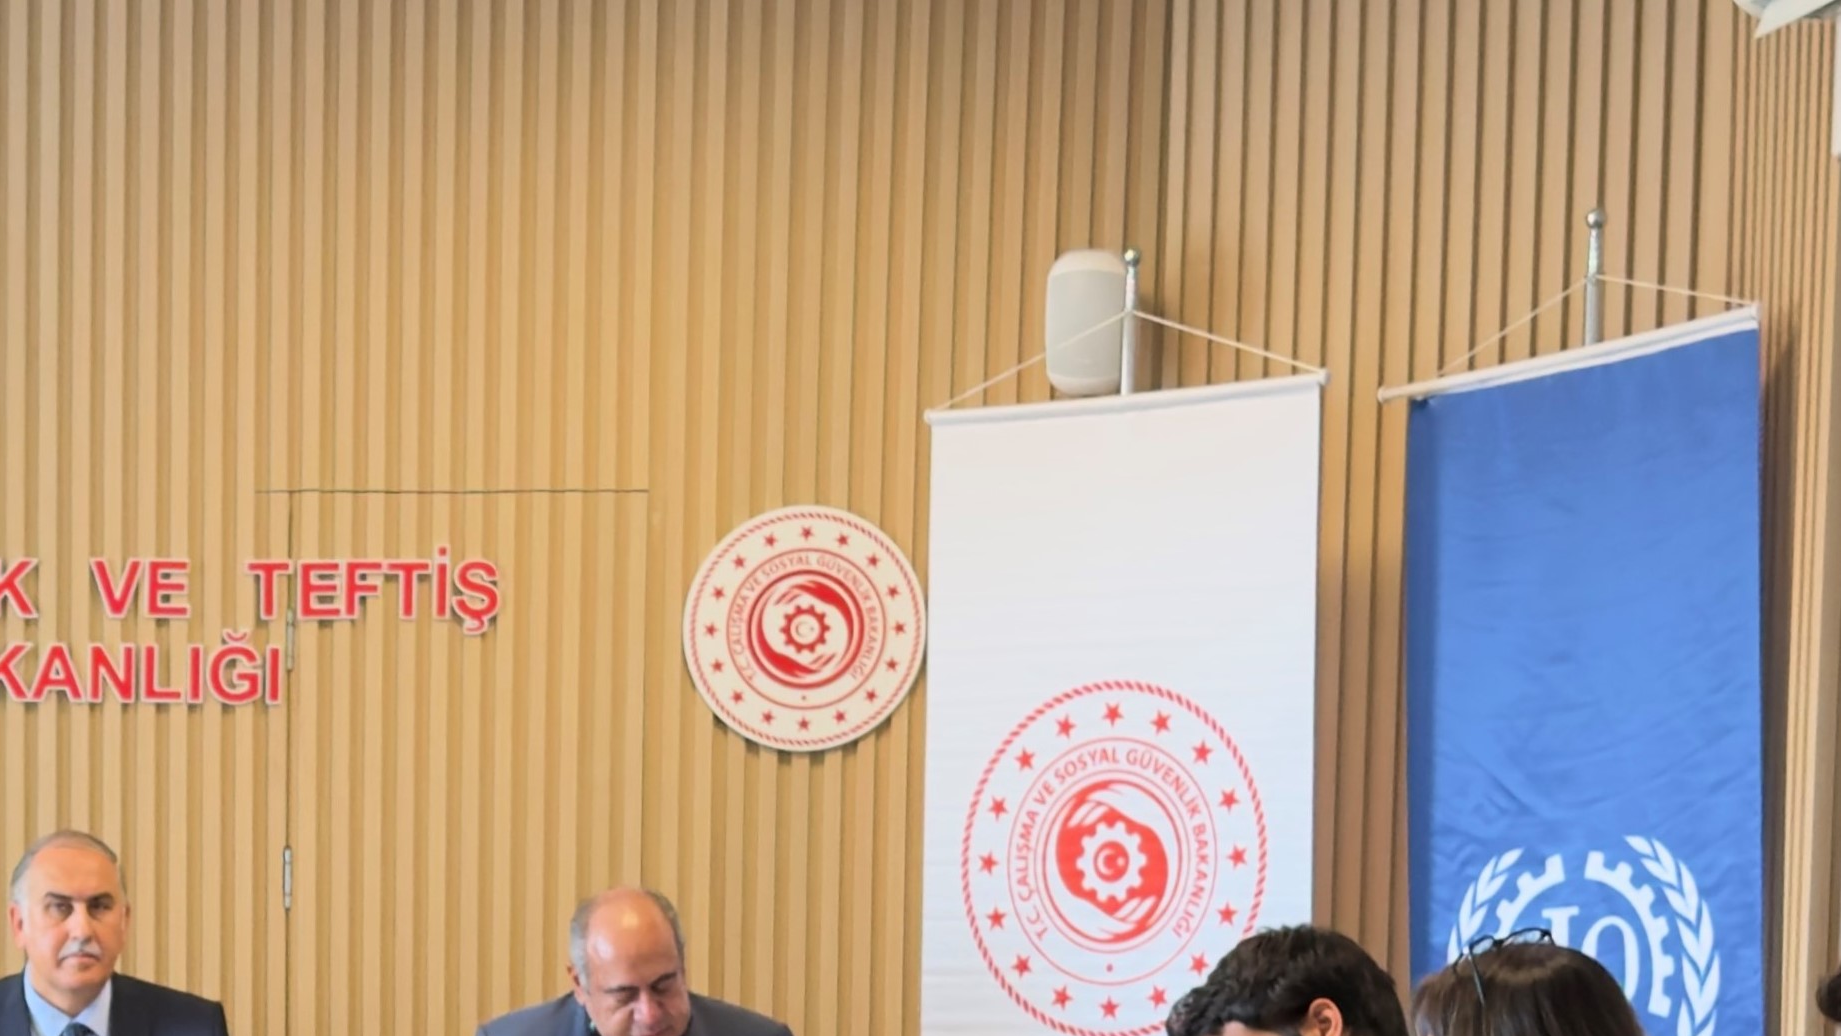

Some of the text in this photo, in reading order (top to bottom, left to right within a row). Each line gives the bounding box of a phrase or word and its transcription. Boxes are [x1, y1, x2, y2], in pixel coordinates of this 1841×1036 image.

[92, 558, 190, 618] VE
[250, 546, 500, 633] TEFTİŞ
[744, 576, 763, 594] VE
[762, 555, 812, 579] SOSYAL
[1015, 810, 1039, 902] ÇALIŞMA
[1034, 780, 1056, 806] VE
[1055, 747, 1120, 784] SOSYAL
[1126, 747, 1203, 820] GÜVENLİK
[1171, 823, 1210, 940] BAKANLIĞI
